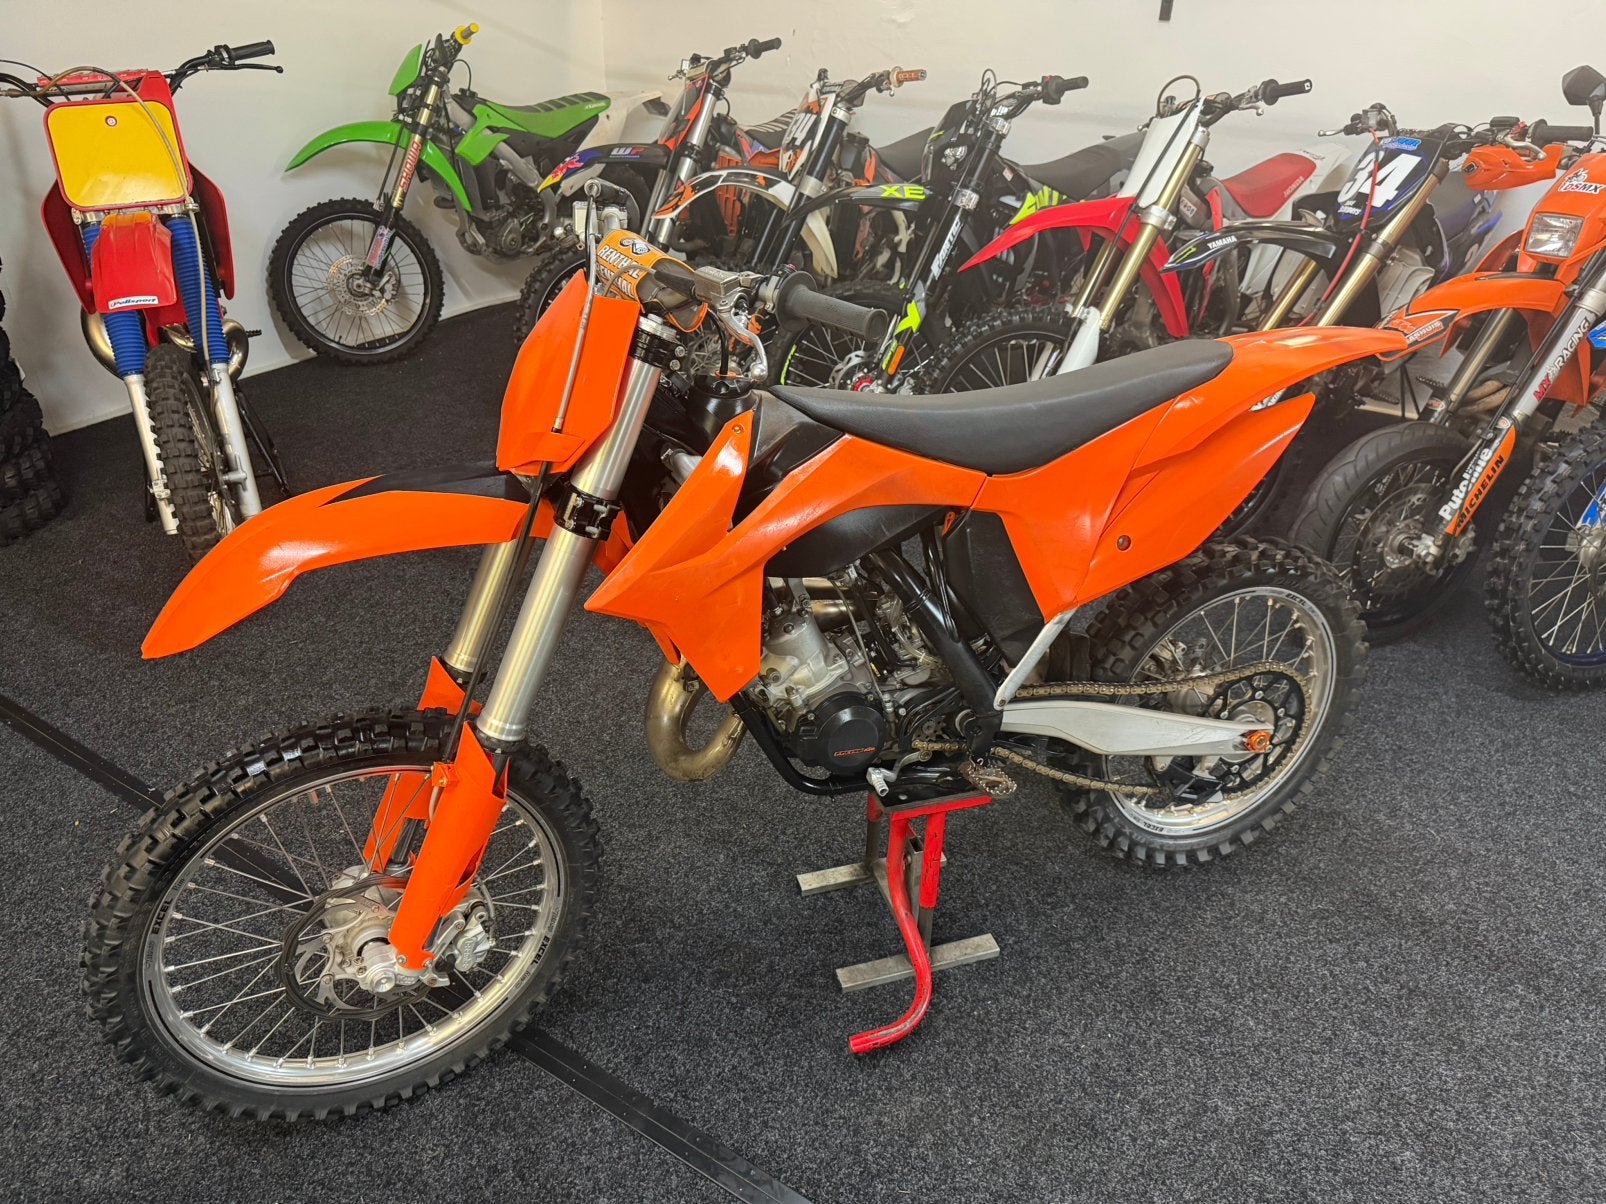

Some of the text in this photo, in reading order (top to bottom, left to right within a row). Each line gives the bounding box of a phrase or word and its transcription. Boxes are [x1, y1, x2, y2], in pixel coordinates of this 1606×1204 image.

[400, 141, 422, 192] SHOWA
[610, 147, 645, 155] WP
[1337, 150, 1422, 208] 34
[1562, 183, 1603, 193] DSMX
[1207, 235, 1238, 249] YAMAHA
[1533, 316, 1592, 400] MX RACING
[1457, 454, 1505, 529] MICHELIN
[152, 898, 173, 935] EXCEL
[531, 935, 550, 966] EXCEL
